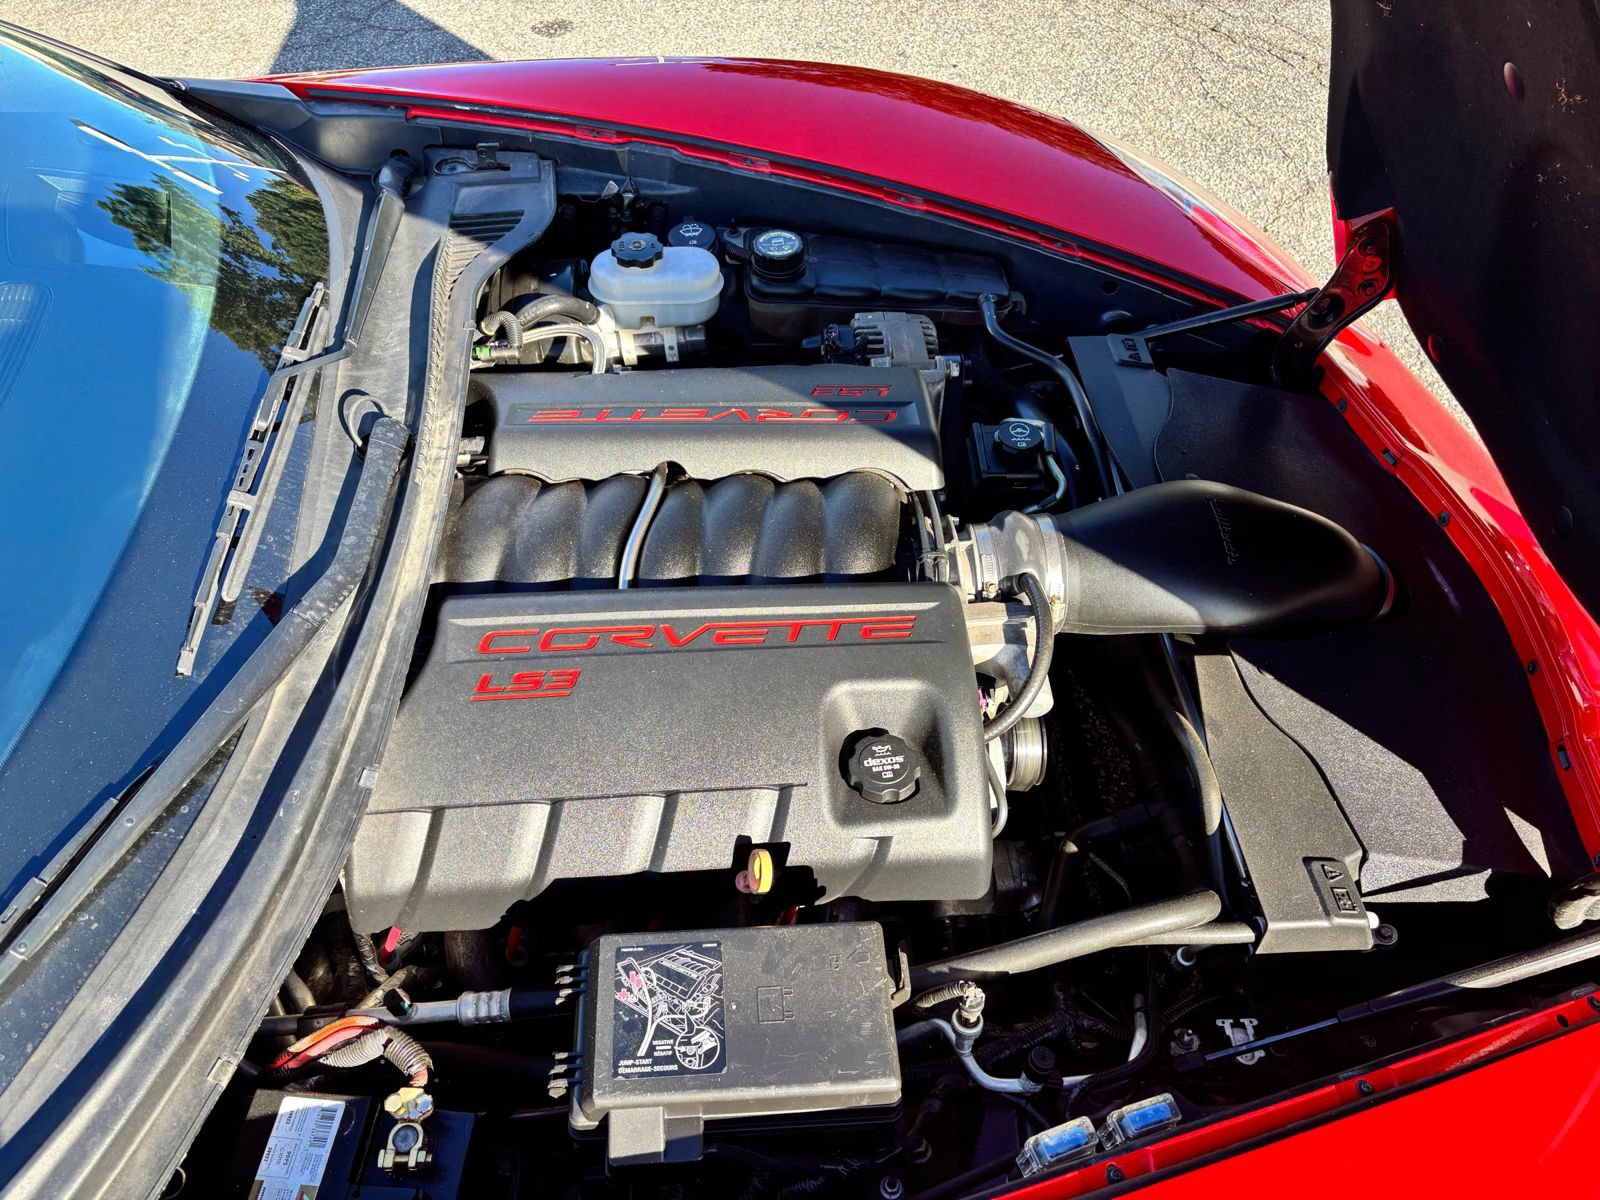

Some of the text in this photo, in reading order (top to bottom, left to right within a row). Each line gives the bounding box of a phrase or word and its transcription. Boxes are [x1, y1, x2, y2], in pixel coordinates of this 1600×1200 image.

[810, 385, 892, 397] LS3
[527, 408, 898, 423] CORVETTE
[477, 616, 917, 654] CORVETTE
[474, 668, 581, 696] LS3
[864, 755, 904, 767] dexos
[618, 1058, 653, 1066] JUMP-START
